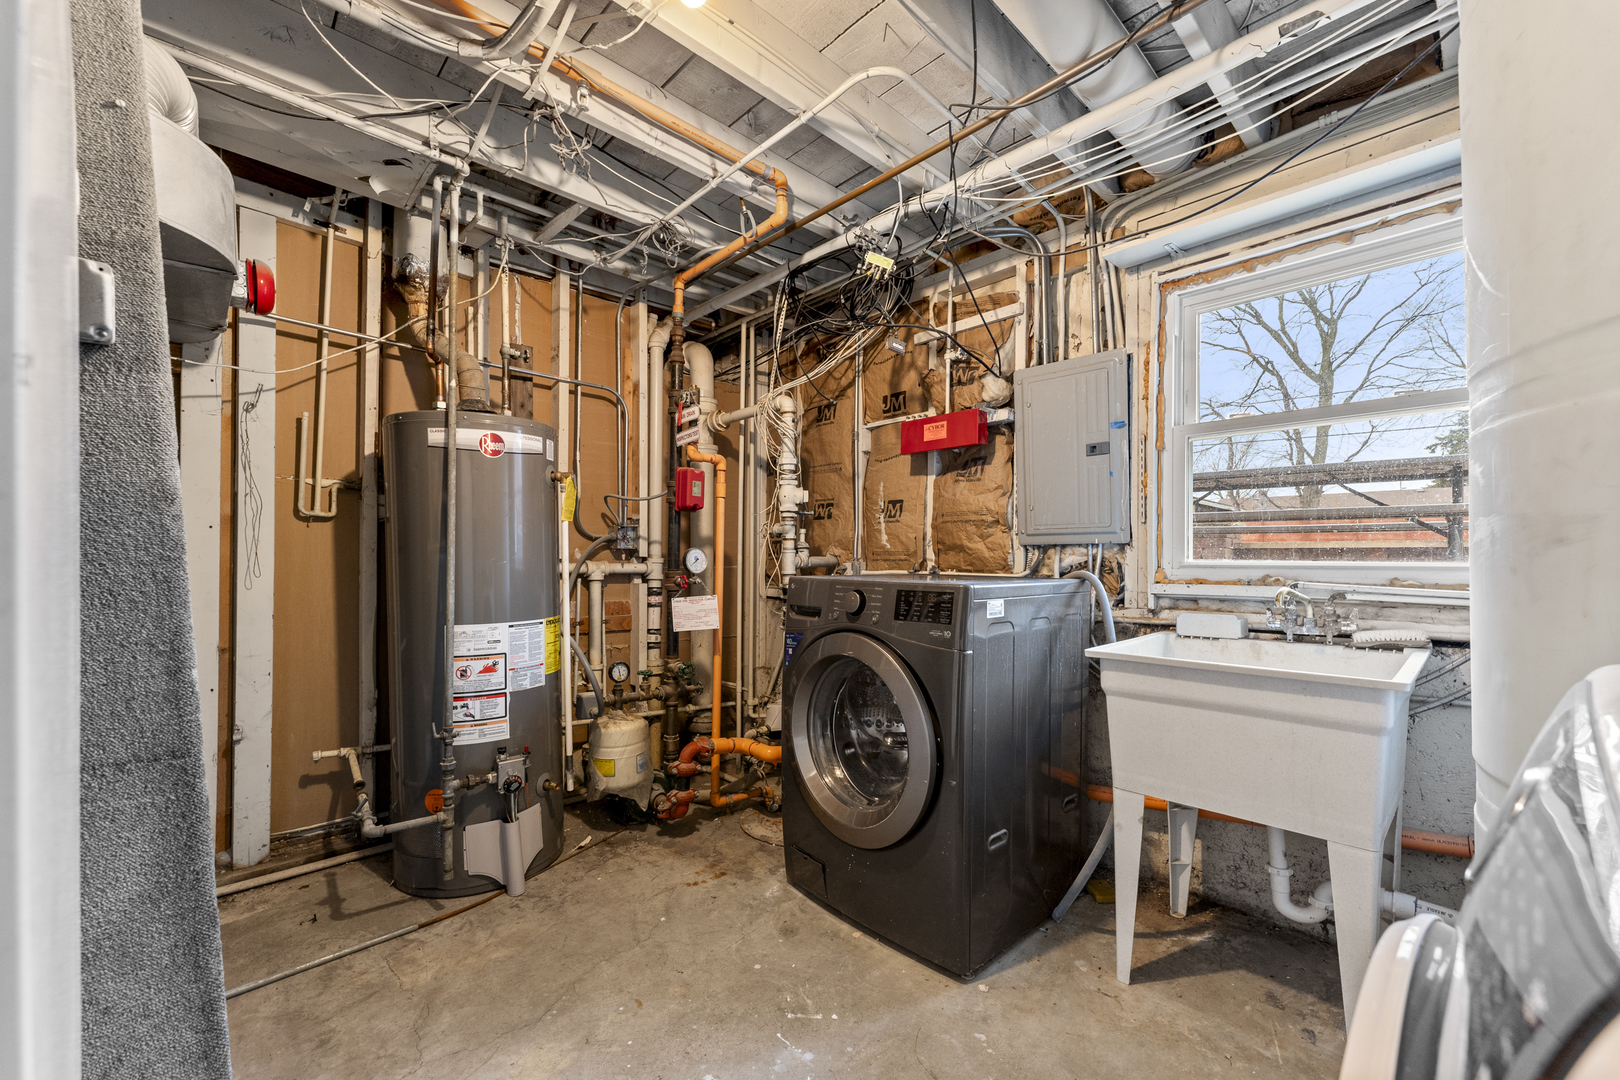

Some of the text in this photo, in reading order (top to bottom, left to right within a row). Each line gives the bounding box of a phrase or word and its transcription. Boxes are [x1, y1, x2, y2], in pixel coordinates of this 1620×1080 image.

[816, 402, 838, 423] JM
[882, 390, 907, 414] JM
[928, 423, 945, 431] CYBOR
[481, 432, 505, 454] Rheem
[956, 455, 988, 478] JM
[813, 502, 834, 520] JM
[878, 499, 904, 519] JM
